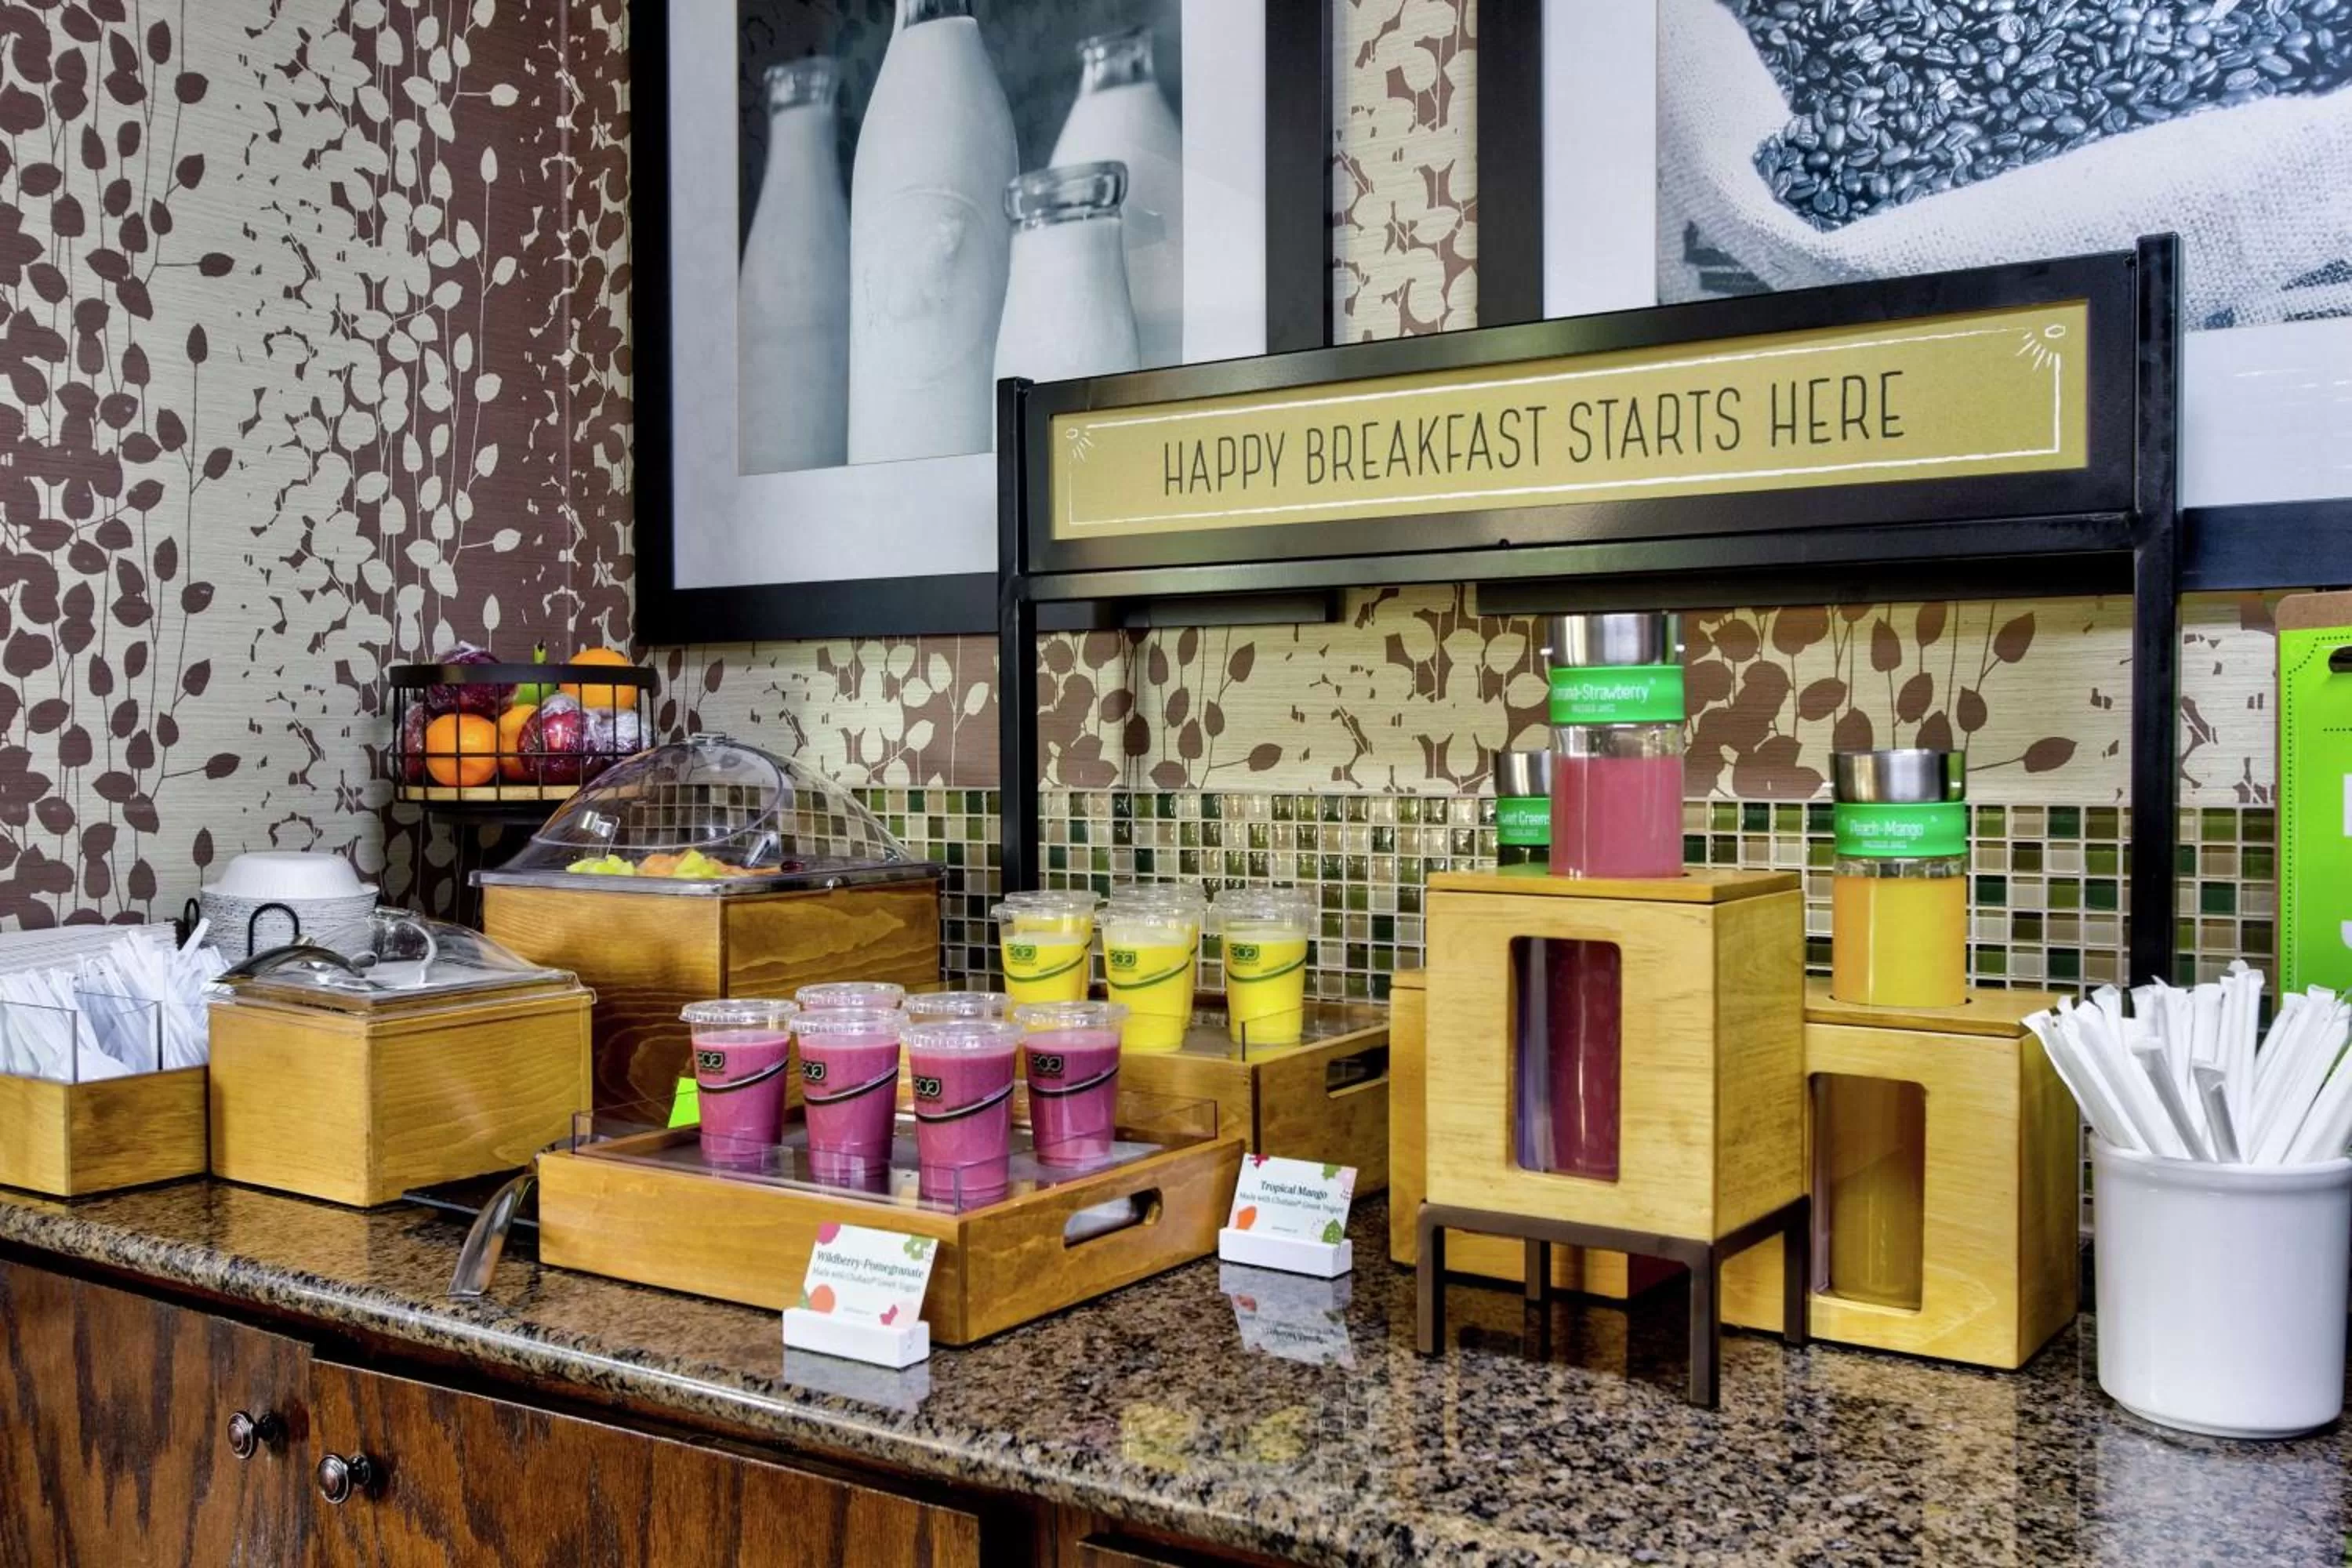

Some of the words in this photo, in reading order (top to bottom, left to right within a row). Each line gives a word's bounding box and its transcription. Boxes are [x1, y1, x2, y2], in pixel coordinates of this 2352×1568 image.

[1163, 431, 1286, 496] HAPPY
[1305, 405, 1548, 486] BREAKFAST
[1568, 386, 1741, 463] STARTS
[1770, 370, 1904, 448] HERE
[1261, 1180, 1296, 1194] Tropical
[1298, 1185, 1328, 1200] Mango
